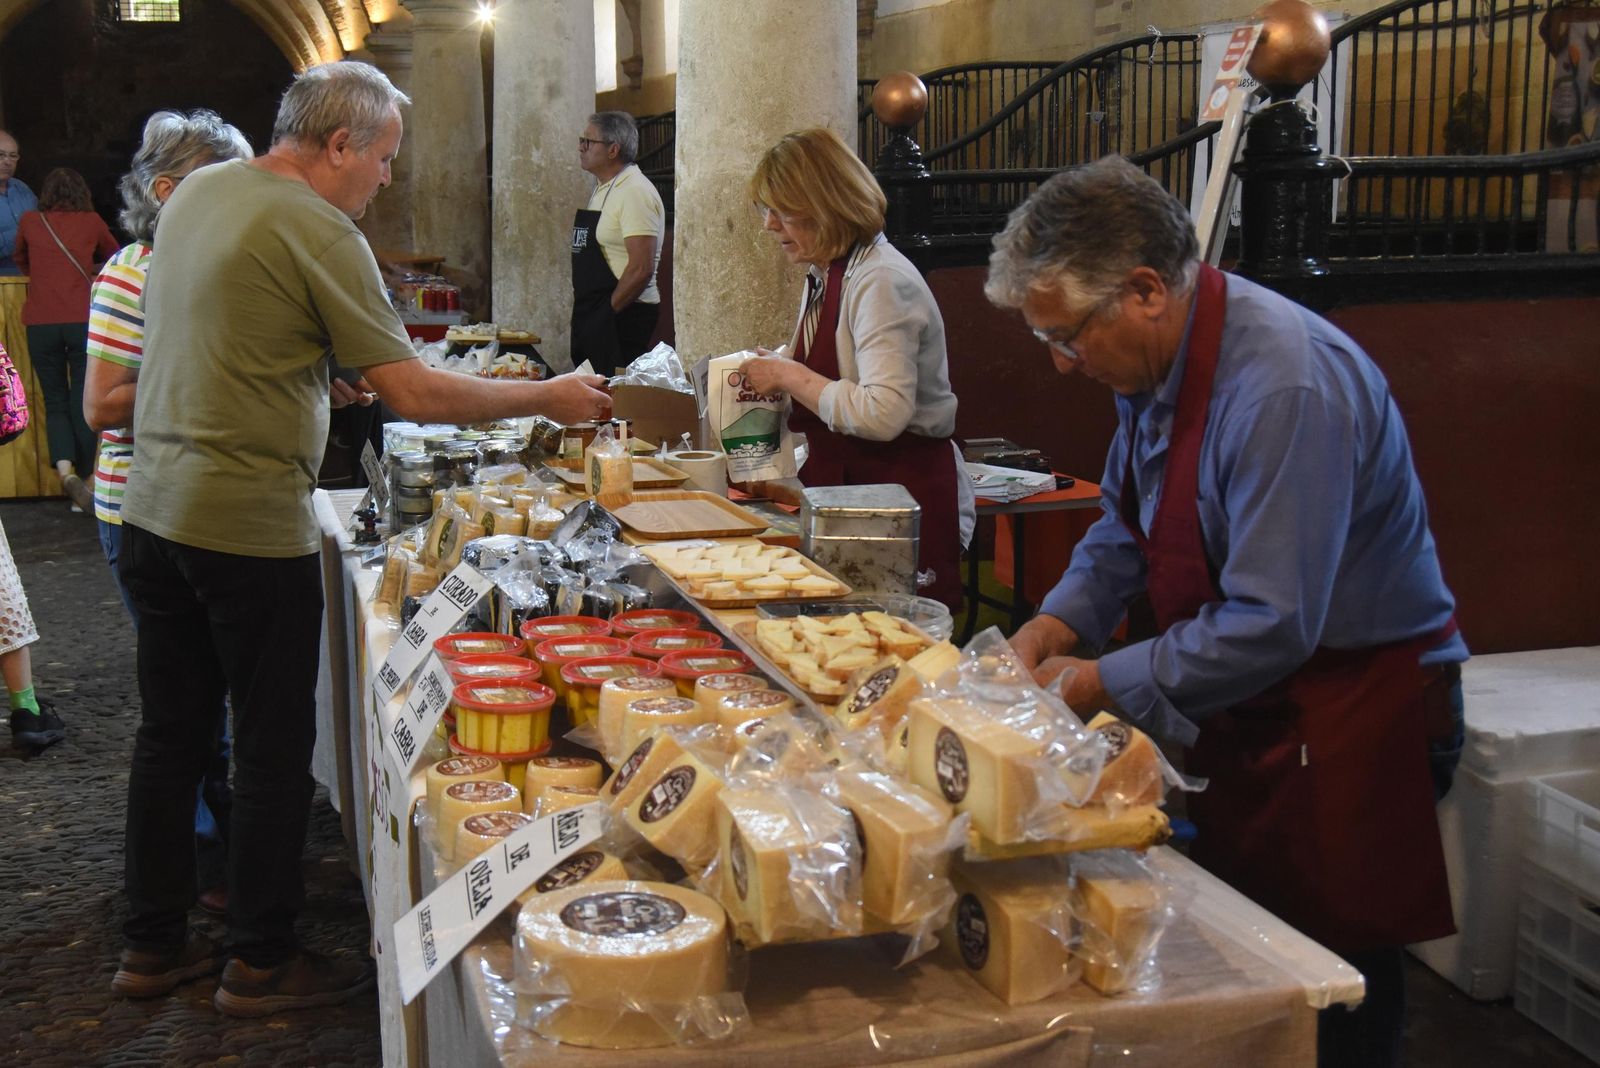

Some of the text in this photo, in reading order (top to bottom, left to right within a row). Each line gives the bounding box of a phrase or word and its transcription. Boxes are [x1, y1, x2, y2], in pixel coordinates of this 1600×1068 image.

[442, 574, 479, 608] CURADO
[430, 606, 439, 617] DE
[405, 621, 428, 647] CABRA
[416, 699, 428, 720] DE
[418, 676, 441, 714] EN ACEITE
[393, 717, 416, 763] CABRA
[510, 842, 530, 871] DE
[469, 858, 493, 916] OVEJA
[420, 904, 438, 970] LECHE CRUDA
